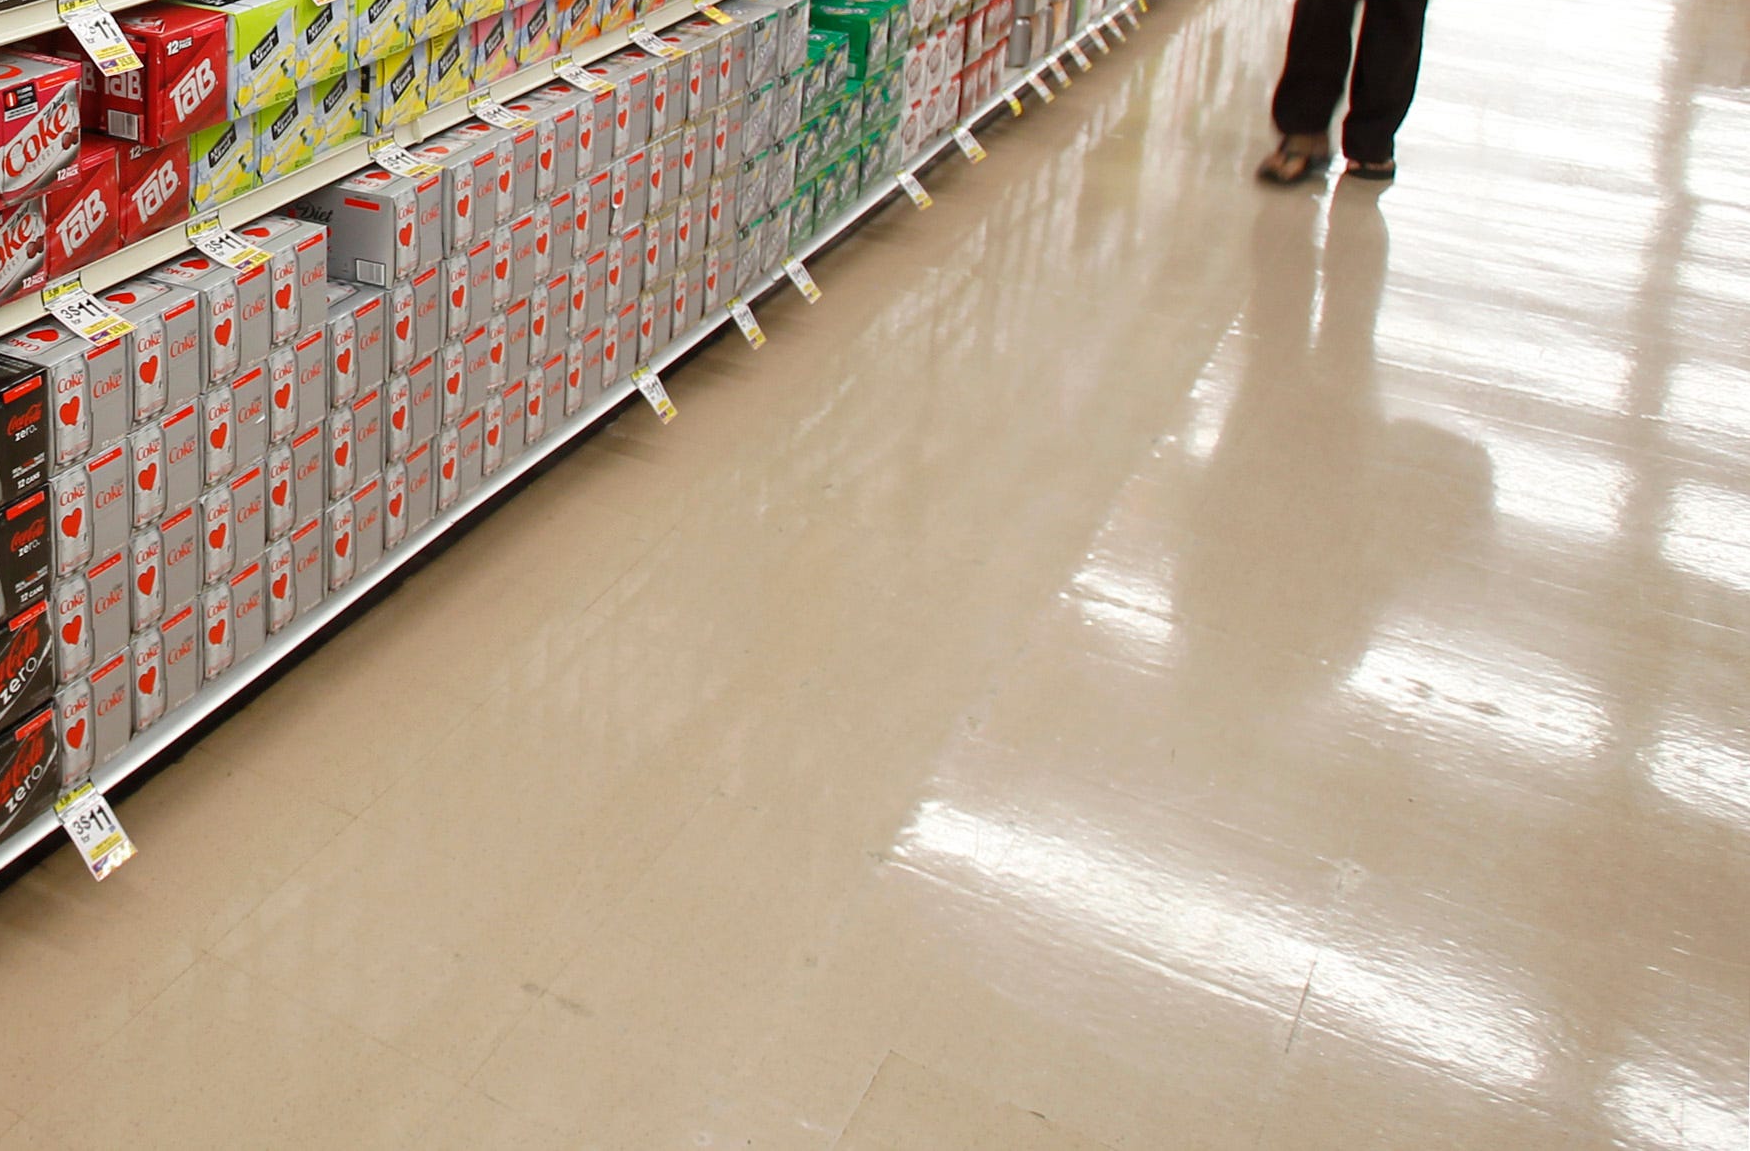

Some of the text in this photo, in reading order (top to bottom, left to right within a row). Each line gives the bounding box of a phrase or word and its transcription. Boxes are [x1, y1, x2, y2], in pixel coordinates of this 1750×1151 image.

[300, 202, 334, 224] Diet
[242, 298, 266, 321] Coke
[57, 372, 84, 395] Coke
